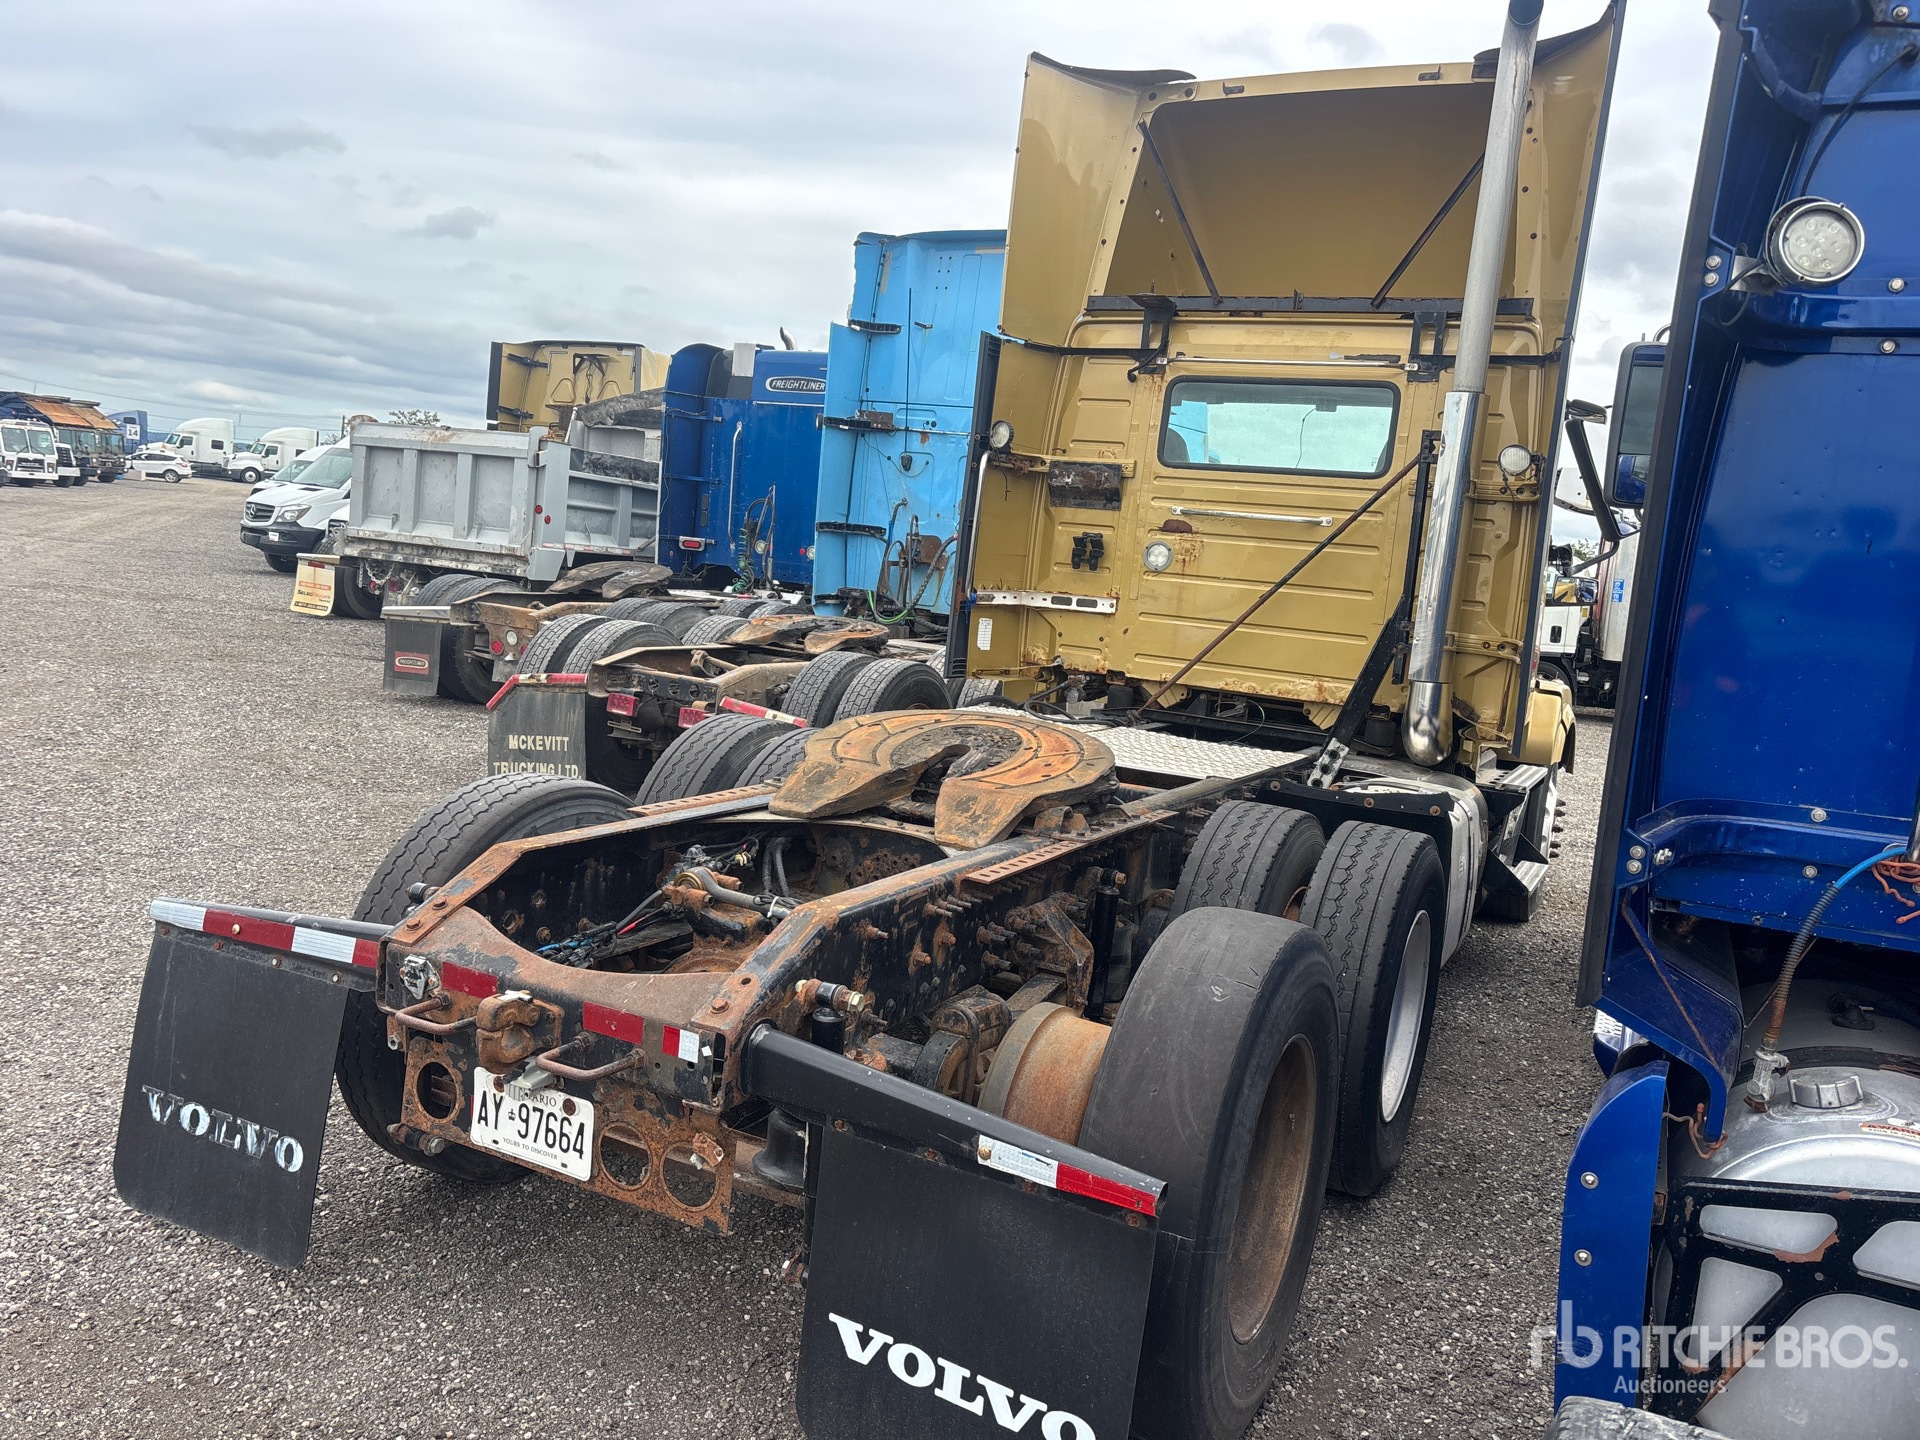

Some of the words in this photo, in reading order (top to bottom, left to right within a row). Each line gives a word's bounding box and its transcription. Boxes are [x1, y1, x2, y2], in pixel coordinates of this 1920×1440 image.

[771, 379, 826, 391] FREIGHTLINER
[508, 734, 570, 752] MCKEVITT
[492, 761, 555, 776] TRUCKING
[140, 1084, 304, 1173] VOLVO
[477, 1089, 504, 1131] AY
[517, 1102, 585, 1160] 97664
[502, 1136, 521, 1148] YOURS
[521, 1143, 530, 1151] TO
[530, 1146, 558, 1161] DISCOVER
[828, 1312, 1097, 1440] VOLVO
